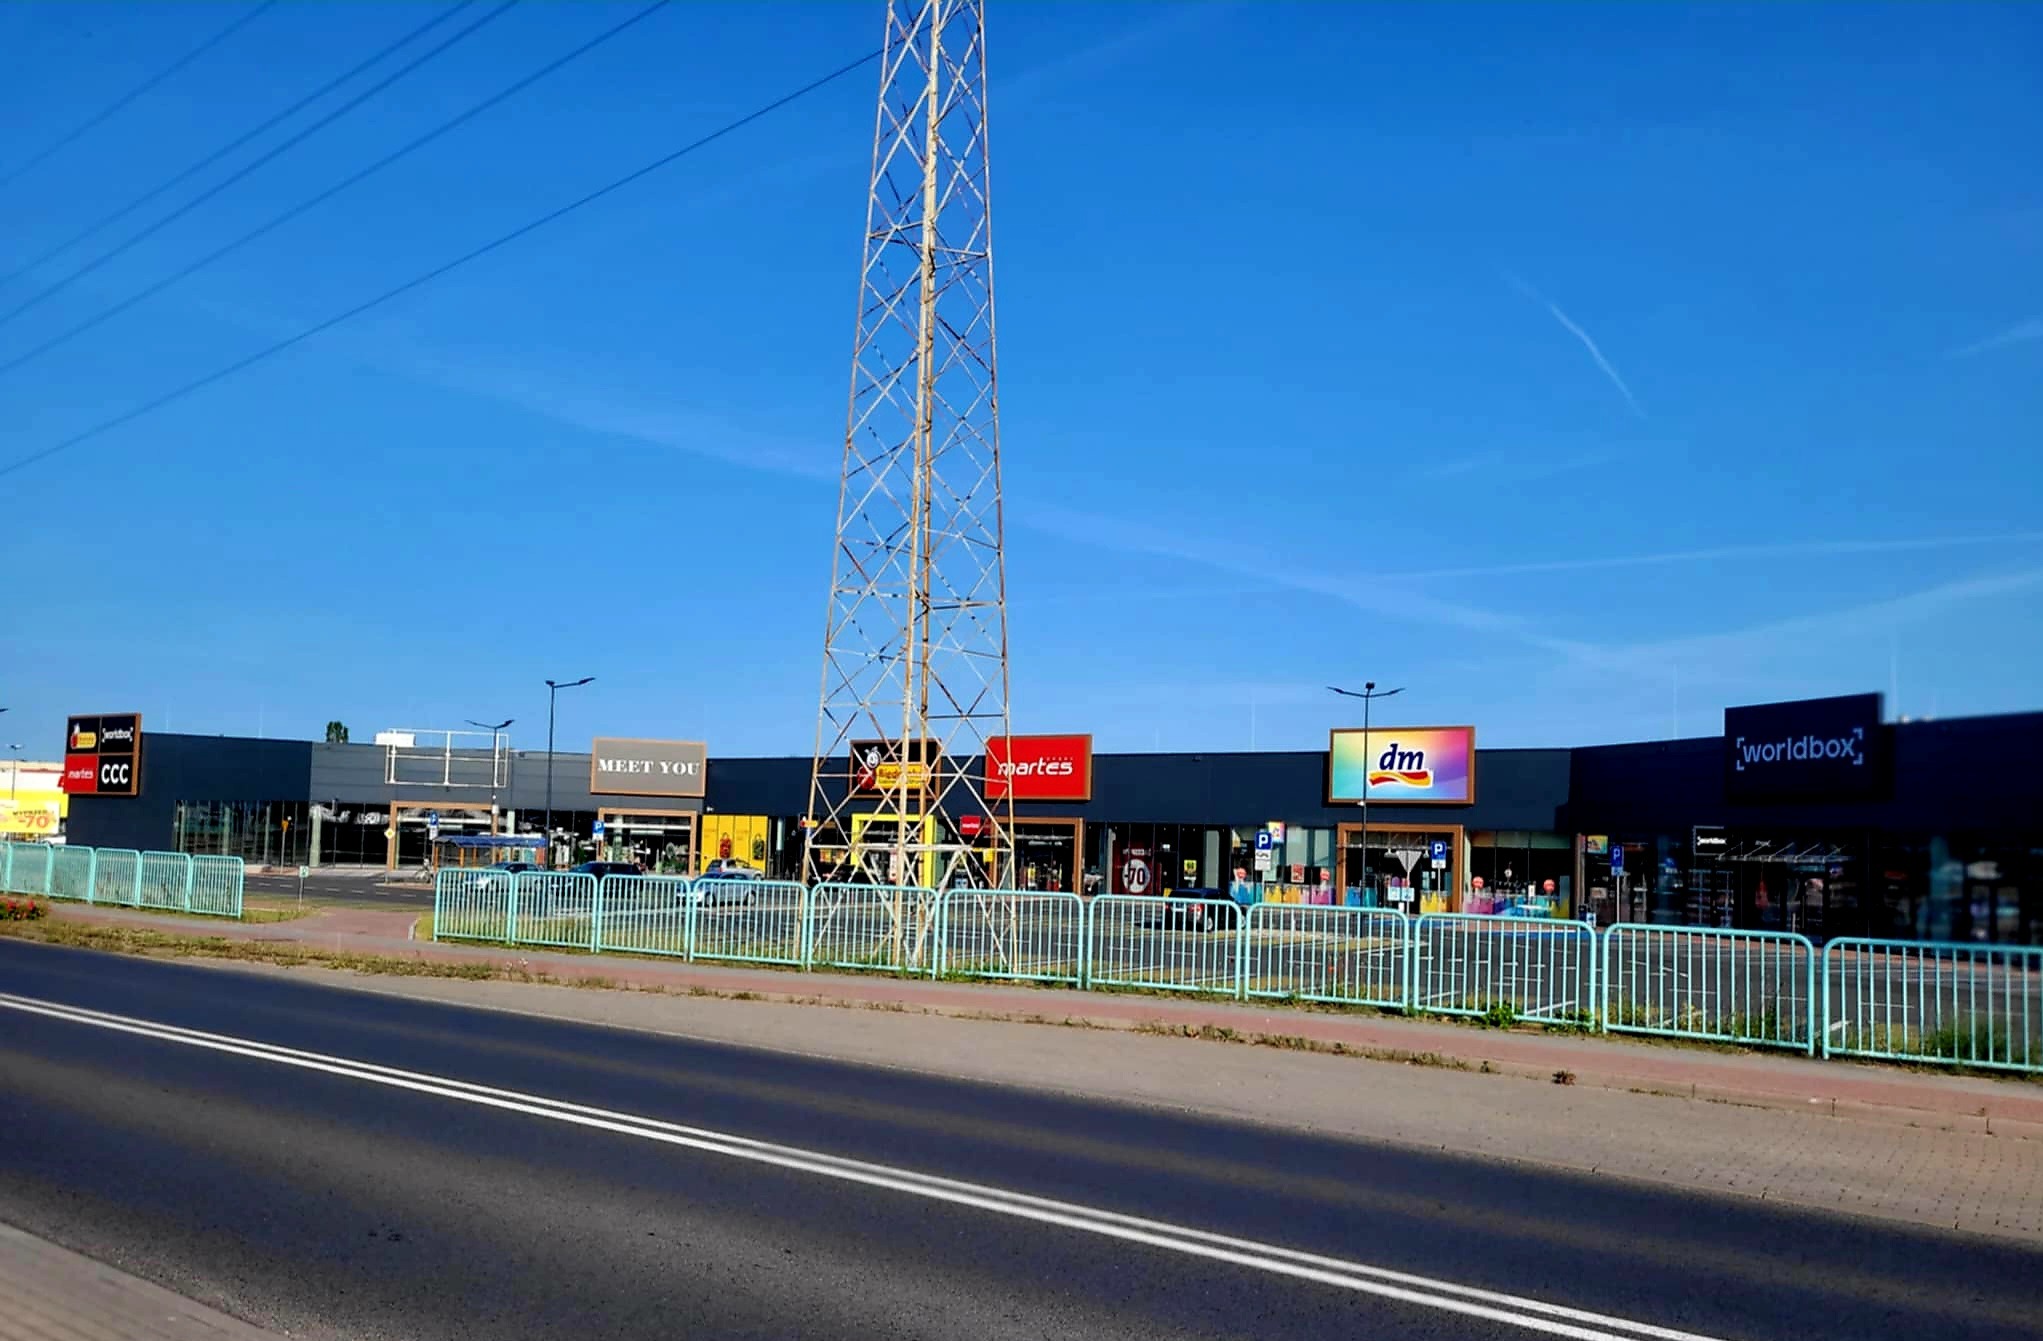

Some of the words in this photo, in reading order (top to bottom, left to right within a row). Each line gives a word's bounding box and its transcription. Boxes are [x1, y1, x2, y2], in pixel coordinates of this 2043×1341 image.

[1379, 743, 1425, 770] dm
[101, 763, 129, 785] CCC
[598, 758, 654, 773] MEET
[659, 761, 700, 776] YOU
[997, 757, 1073, 776] martes
[1258, 834, 1269, 848] P
[1434, 843, 1443, 855] P
[1613, 848, 1621, 860] P
[1123, 867, 1146, 886] -70
